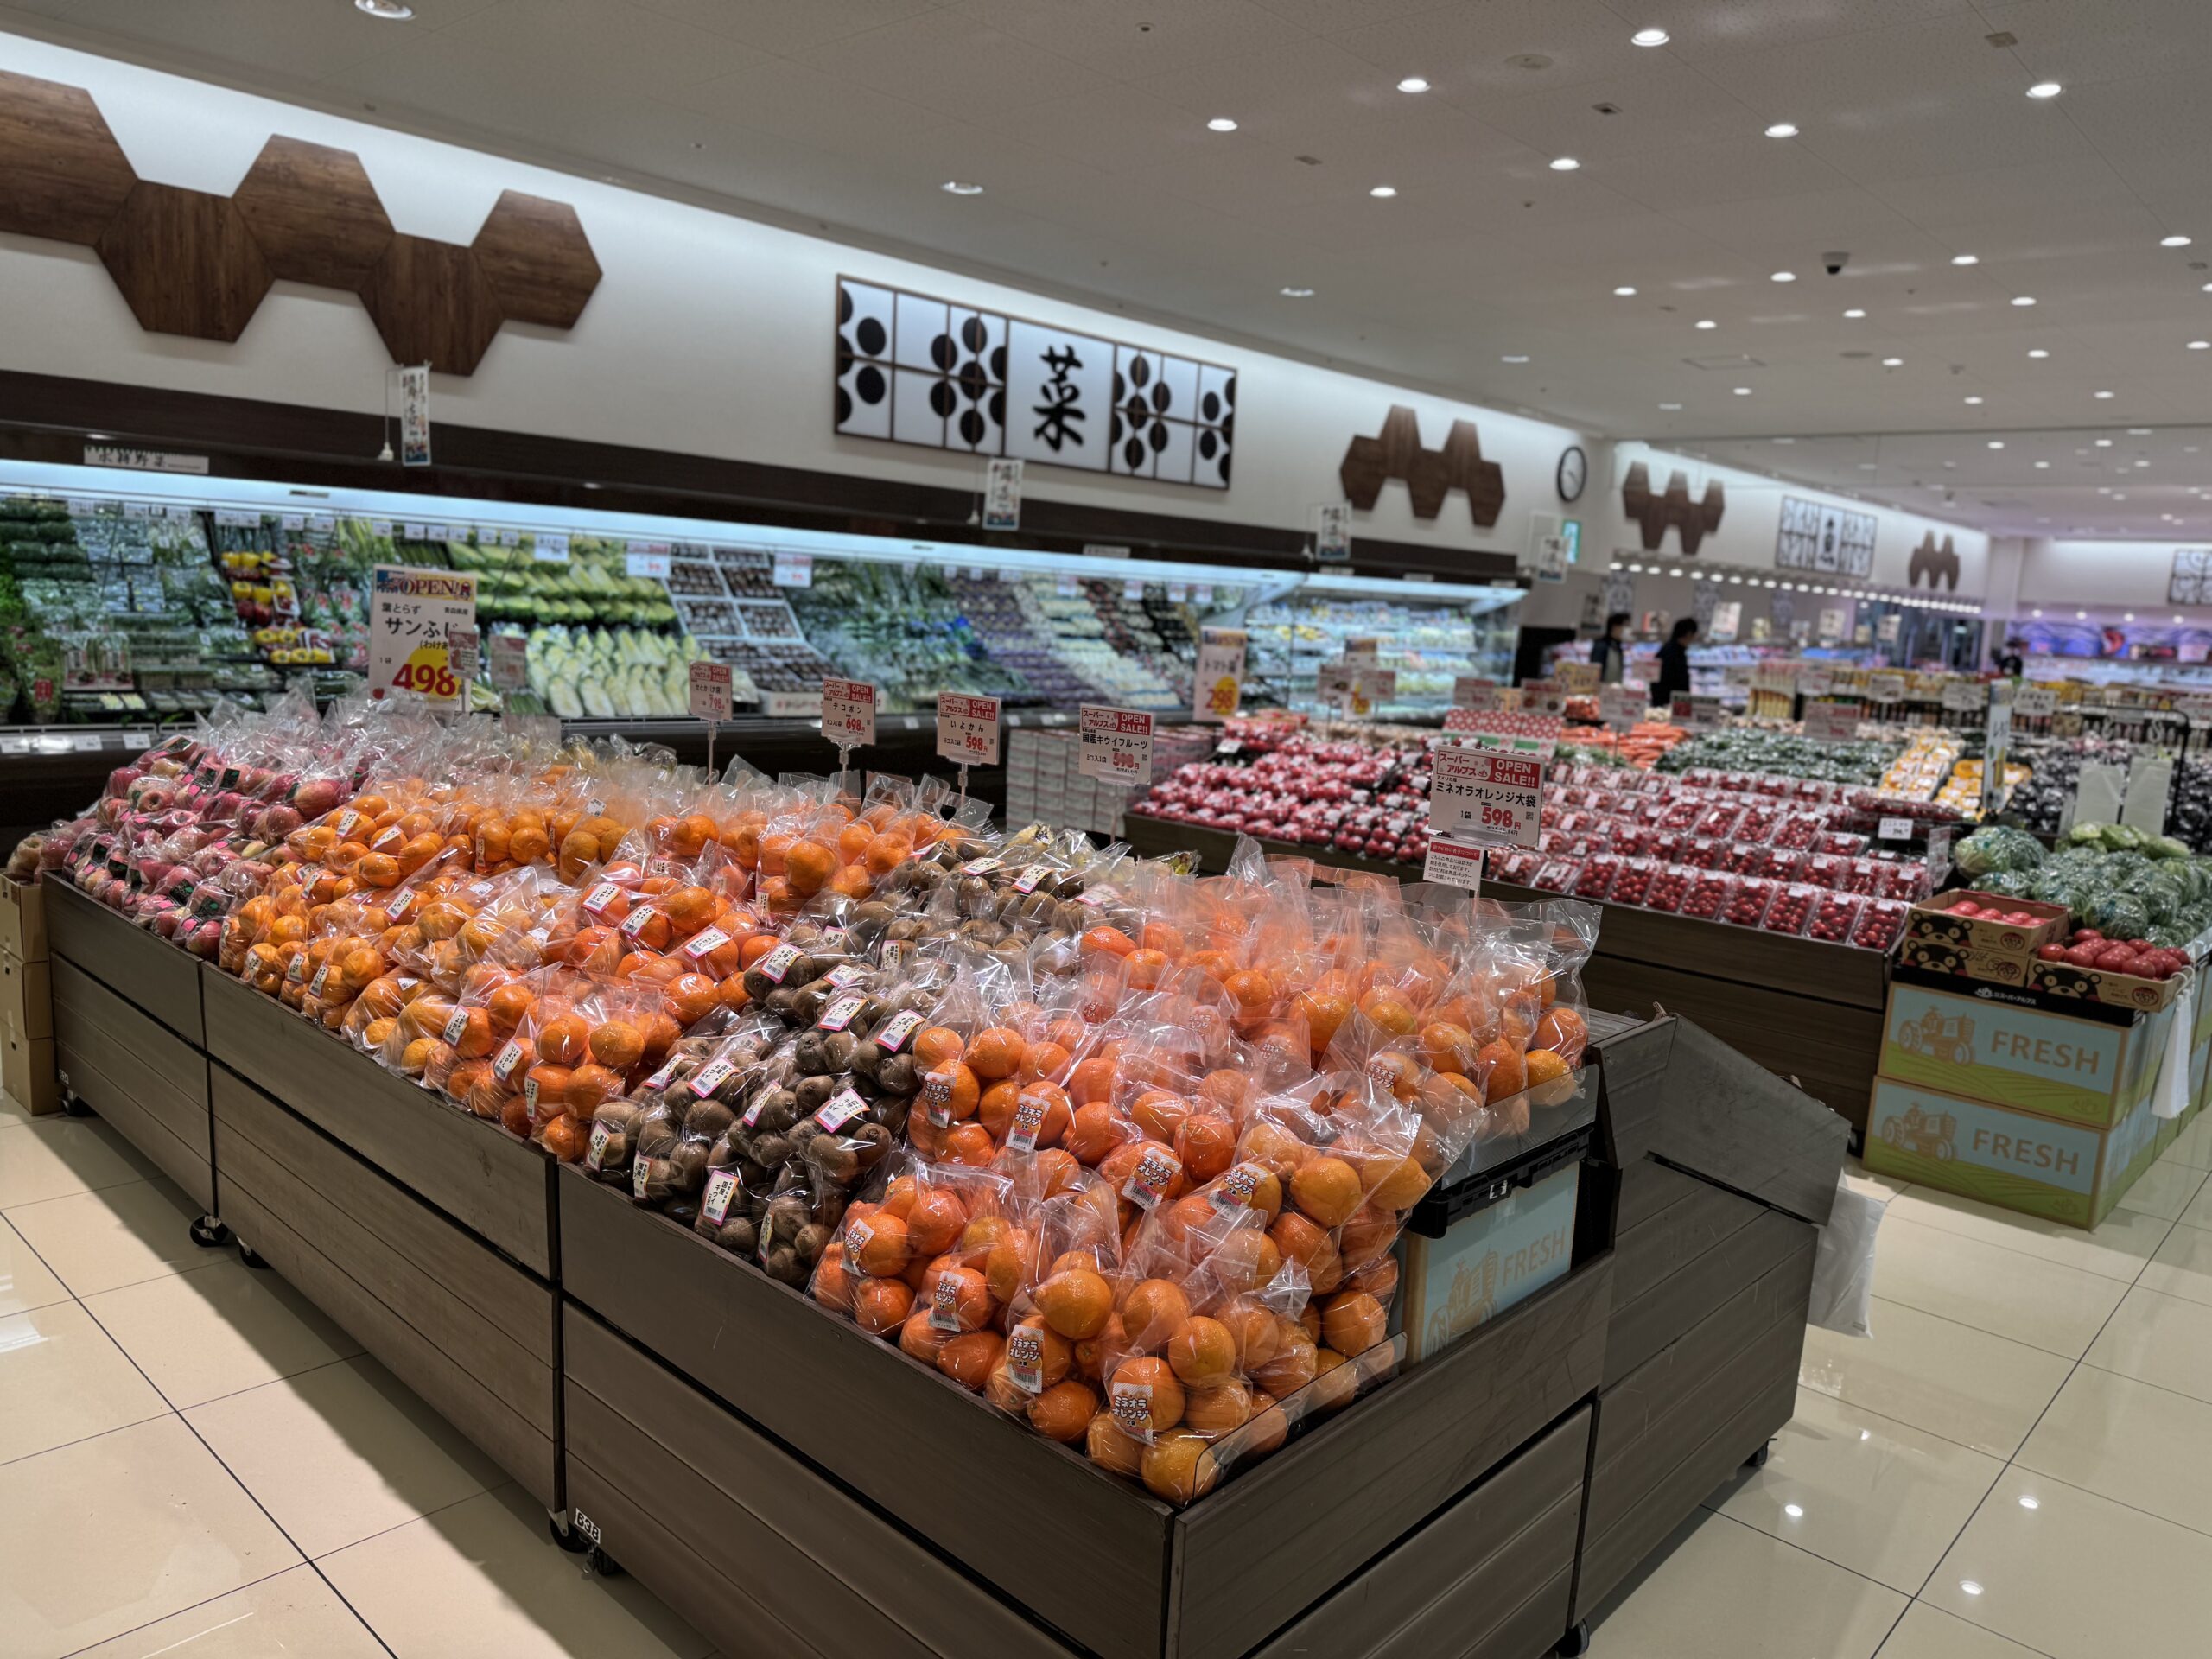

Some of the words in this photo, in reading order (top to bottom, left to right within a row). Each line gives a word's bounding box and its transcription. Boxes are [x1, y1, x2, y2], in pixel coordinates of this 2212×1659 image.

[1033, 344, 1086, 452] 菜
[399, 579, 459, 595] OPEN!
[382, 602, 421, 614] 葉とらず
[385, 617, 458, 639] サンふじ
[392, 663, 455, 696] 498
[851, 694, 871, 702] SALE!!
[833, 702, 862, 714] デコポン
[973, 701, 991, 710] OPEN
[972, 709, 994, 720] SALE!!
[1122, 714, 1145, 723] OPEN
[846, 718, 861, 731] 698
[950, 721, 983, 733] いよかん
[1089, 719, 1109, 728] アルプス
[1121, 724, 1147, 734] SALE!!
[966, 736, 983, 751] 598
[1082, 733, 1147, 749] 国産キウイフルーツ
[1113, 753, 1134, 768] 598
[1440, 753, 1469, 764] スーパー
[1447, 765, 1477, 776] アルプス
[1496, 760, 1531, 773] OPEN
[1495, 772, 1535, 786] SALE!!
[1436, 781, 1536, 807] ミネオラオレンジ大袋
[1460, 810, 1471, 819] 1袋
[1482, 807, 1513, 828] 598
[1991, 1030, 2100, 1075] FRESH
[705, 1065, 721, 1078] キウイ
[716, 1065, 728, 1074] 国産
[926, 1081, 950, 1094] ミネオラ
[925, 1090, 950, 1102] オレンジ
[1018, 1104, 1043, 1118] ミネオラ
[1015, 1113, 1041, 1126] オレンジ
[1973, 1128, 2080, 1175] FRESH
[638, 1162, 645, 1176] 国産
[1143, 1156, 1173, 1178] ミネオラ
[1137, 1164, 1168, 1186] オレンジ
[1230, 1168, 1256, 1186] ミネオラ
[720, 1180, 728, 1196] 国産
[1225, 1175, 1253, 1194] オレンジ
[709, 1184, 721, 1204] キウイ
[1503, 1225, 1566, 1286] FRESH
[938, 1281, 957, 1295] ミネオラ
[935, 1292, 956, 1305] オレンジ
[1012, 1337, 1038, 1351] ミネオラ
[1009, 1348, 1039, 1362] オレンジ
[1114, 1395, 1147, 1409] ミネオラ
[1111, 1407, 1149, 1421] オレンジ
[577, 1512, 599, 1541] 638
